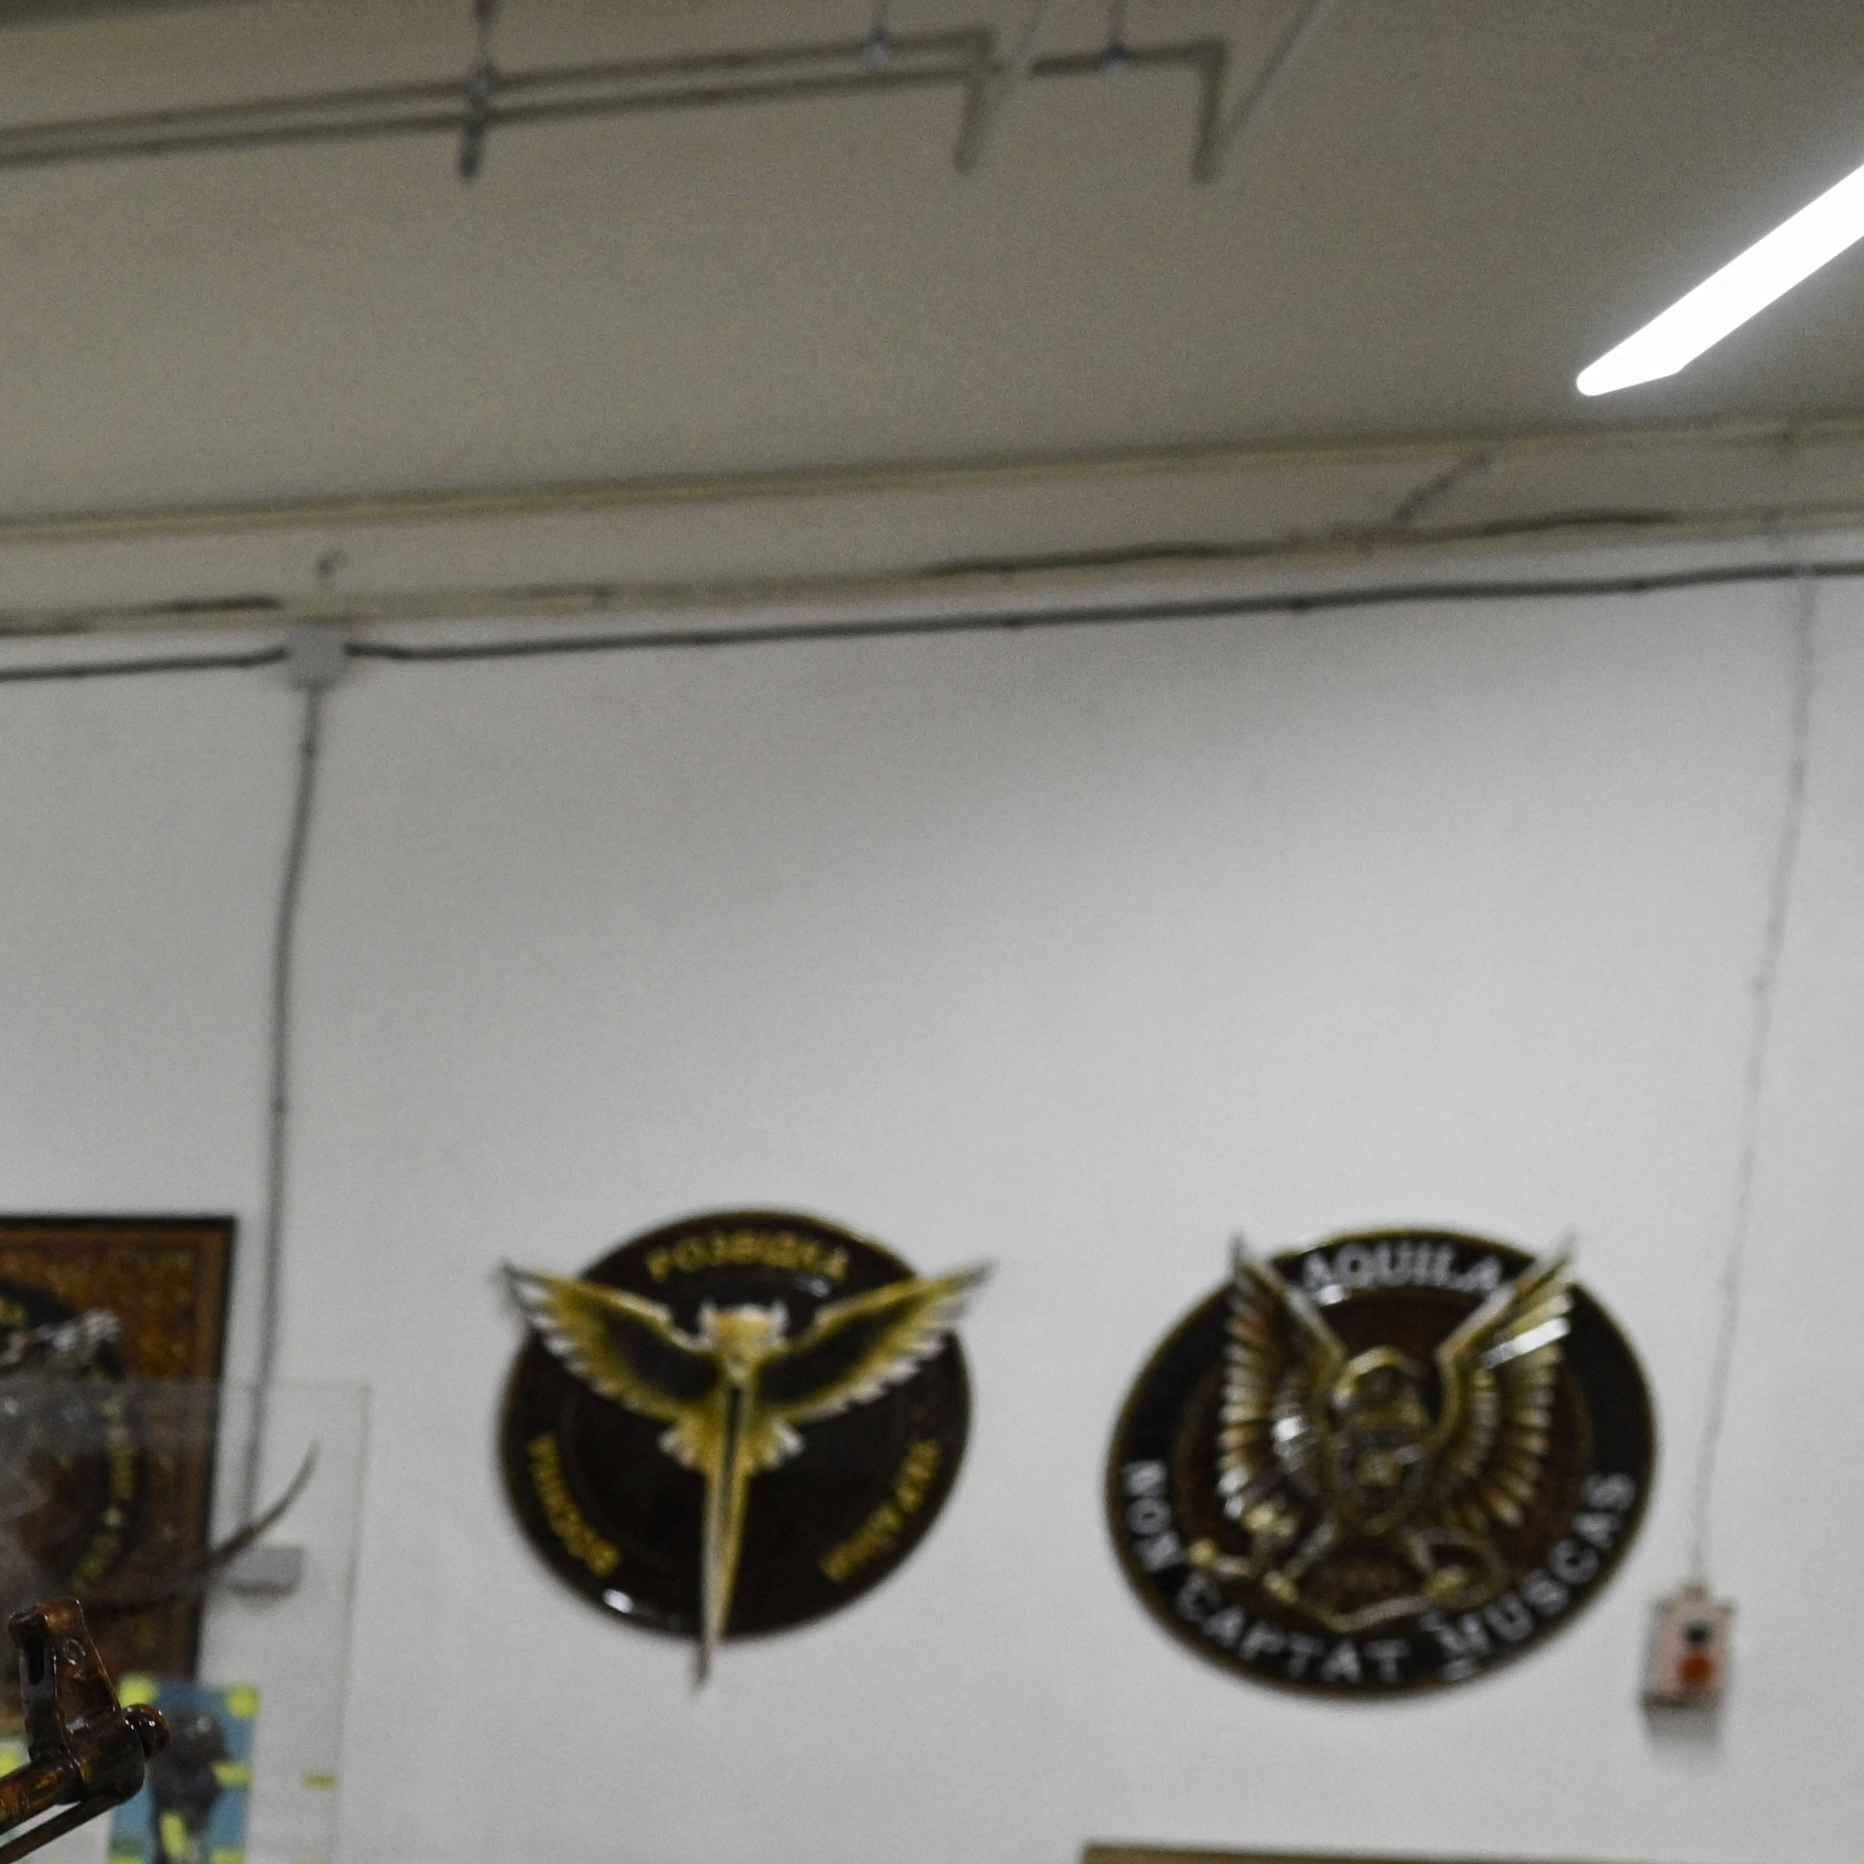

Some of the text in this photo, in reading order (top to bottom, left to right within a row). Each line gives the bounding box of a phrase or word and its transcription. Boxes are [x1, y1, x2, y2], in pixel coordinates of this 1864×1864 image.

[1302, 1243, 1501, 1294] AQUILA
[1124, 1459, 1636, 1682] NON CAPTAT MUSCAS
